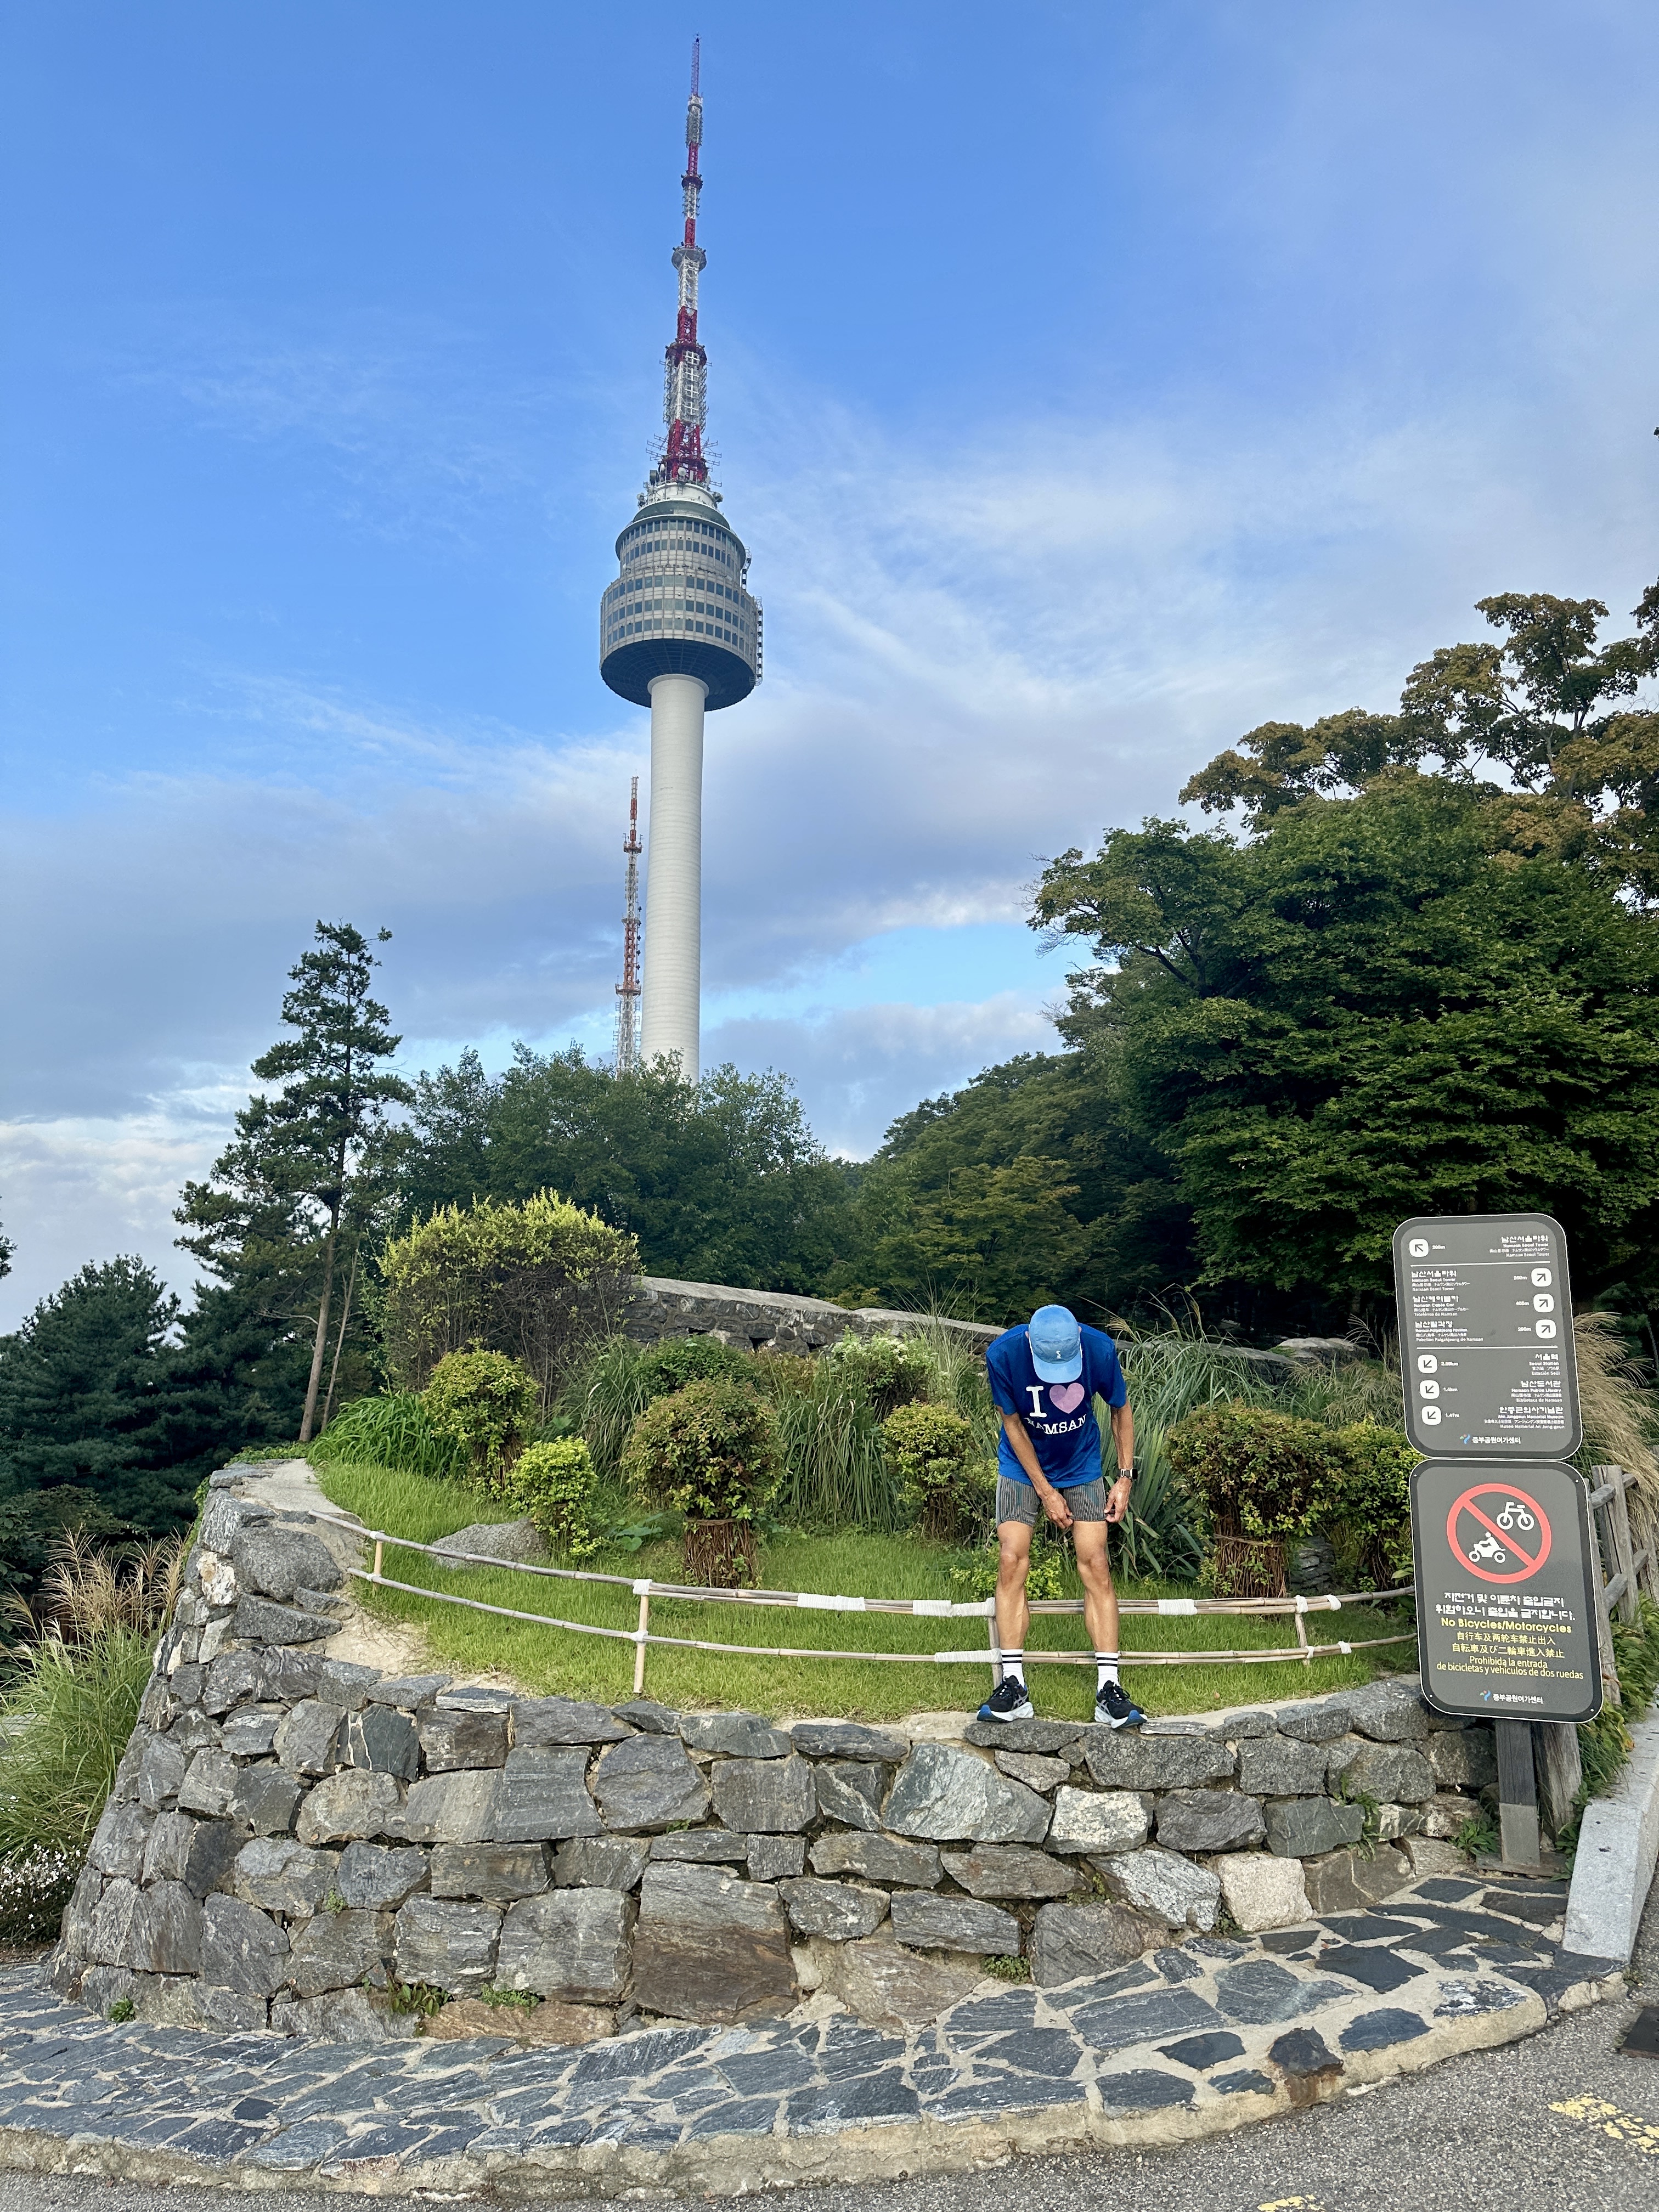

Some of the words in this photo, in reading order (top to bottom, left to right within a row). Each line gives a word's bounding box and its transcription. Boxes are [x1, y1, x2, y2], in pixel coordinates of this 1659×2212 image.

[1026, 1385, 1047, 1418] I
[1444, 1592, 1474, 1603] 자전거
[1476, 1593, 1487, 1604] 및
[1490, 1594, 1520, 1605] 이륜차
[1523, 1595, 1564, 1607] 출입금지
[1436, 1604, 1485, 1616] 위험하오니
[1487, 1606, 1518, 1618] 출입을
[1521, 1608, 1576, 1621] 금지합니다.
[1441, 1617, 1455, 1627] No
[1458, 1618, 1572, 1633] Bicycles/Motorcycles
[1457, 1631, 1555, 1645] 自行车及两轮车禁止出入
[1452, 1643, 1565, 1658] 自転車及び二輪車進入禁止
[1470, 1655, 1506, 1666] Prohibida
[1509, 1658, 1515, 1666] la
[1517, 1660, 1548, 1668] entrada
[1436, 1662, 1447, 1671] de
[1448, 1662, 1483, 1673] bicicletas
[1485, 1666, 1489, 1675] y
[1490, 1665, 1527, 1676] vehículos
[1528, 1668, 1539, 1677] de
[1540, 1668, 1555, 1678] dos
[1556, 1670, 1584, 1679] ruedas
